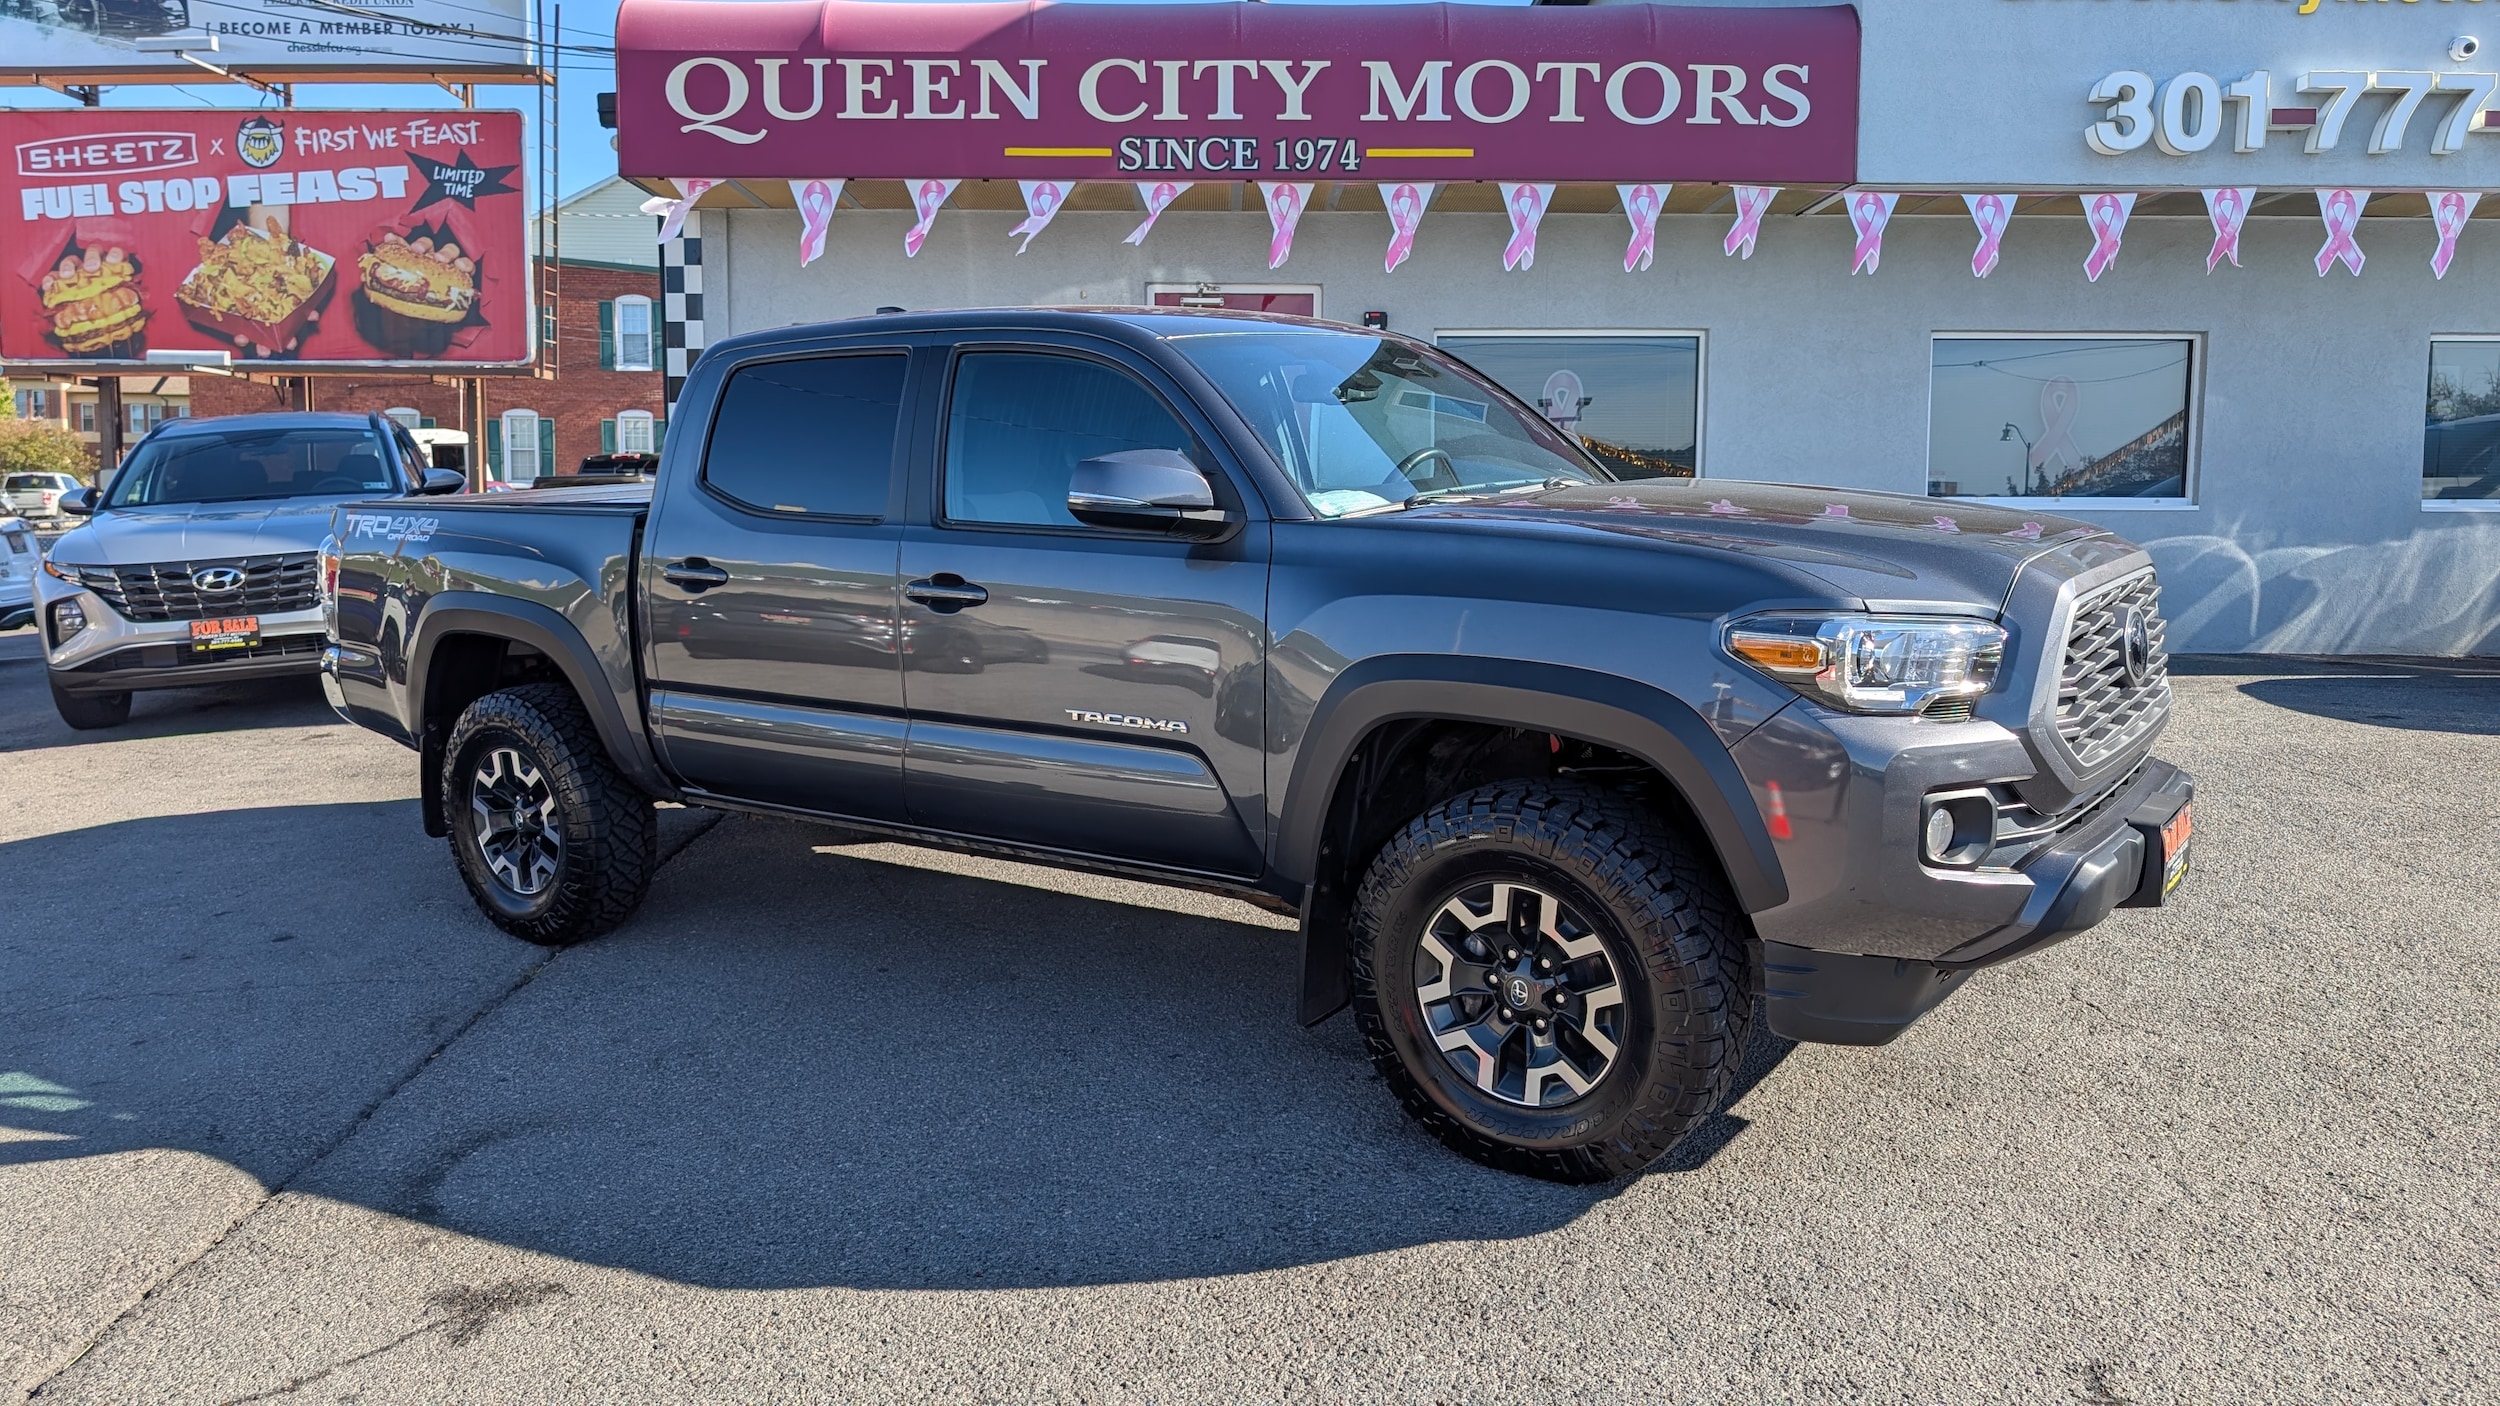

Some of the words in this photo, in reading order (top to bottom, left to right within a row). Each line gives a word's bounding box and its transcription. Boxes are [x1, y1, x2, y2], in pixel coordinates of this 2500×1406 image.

[219, 22, 292, 35] BECOME
[299, 22, 311, 34] A
[319, 22, 393, 35] MEMBER
[403, 23, 461, 36] TODAY
[664, 56, 1048, 145] QUEEN
[1078, 57, 1331, 123] CITY
[1359, 58, 1812, 128] MOTORS
[29, 139, 185, 170] SHEETZ
[294, 125, 359, 156] FIRST
[361, 123, 399, 151] WE
[400, 118, 482, 149] FEAST
[1117, 135, 1260, 173] SINCE
[1272, 136, 1361, 173] 1974
[433, 166, 486, 185] LIMITED
[20, 183, 115, 221] FUEL
[118, 176, 221, 214] STOP
[226, 165, 410, 208] FEAST
[443, 182, 474, 199] TIME
[346, 514, 393, 538] TRD
[387, 533, 405, 541] OFF
[405, 534, 430, 542] ROAD
[191, 620, 222, 636] FOR
[222, 617, 258, 632] SALE
[1064, 708, 1190, 734] TACOMA
